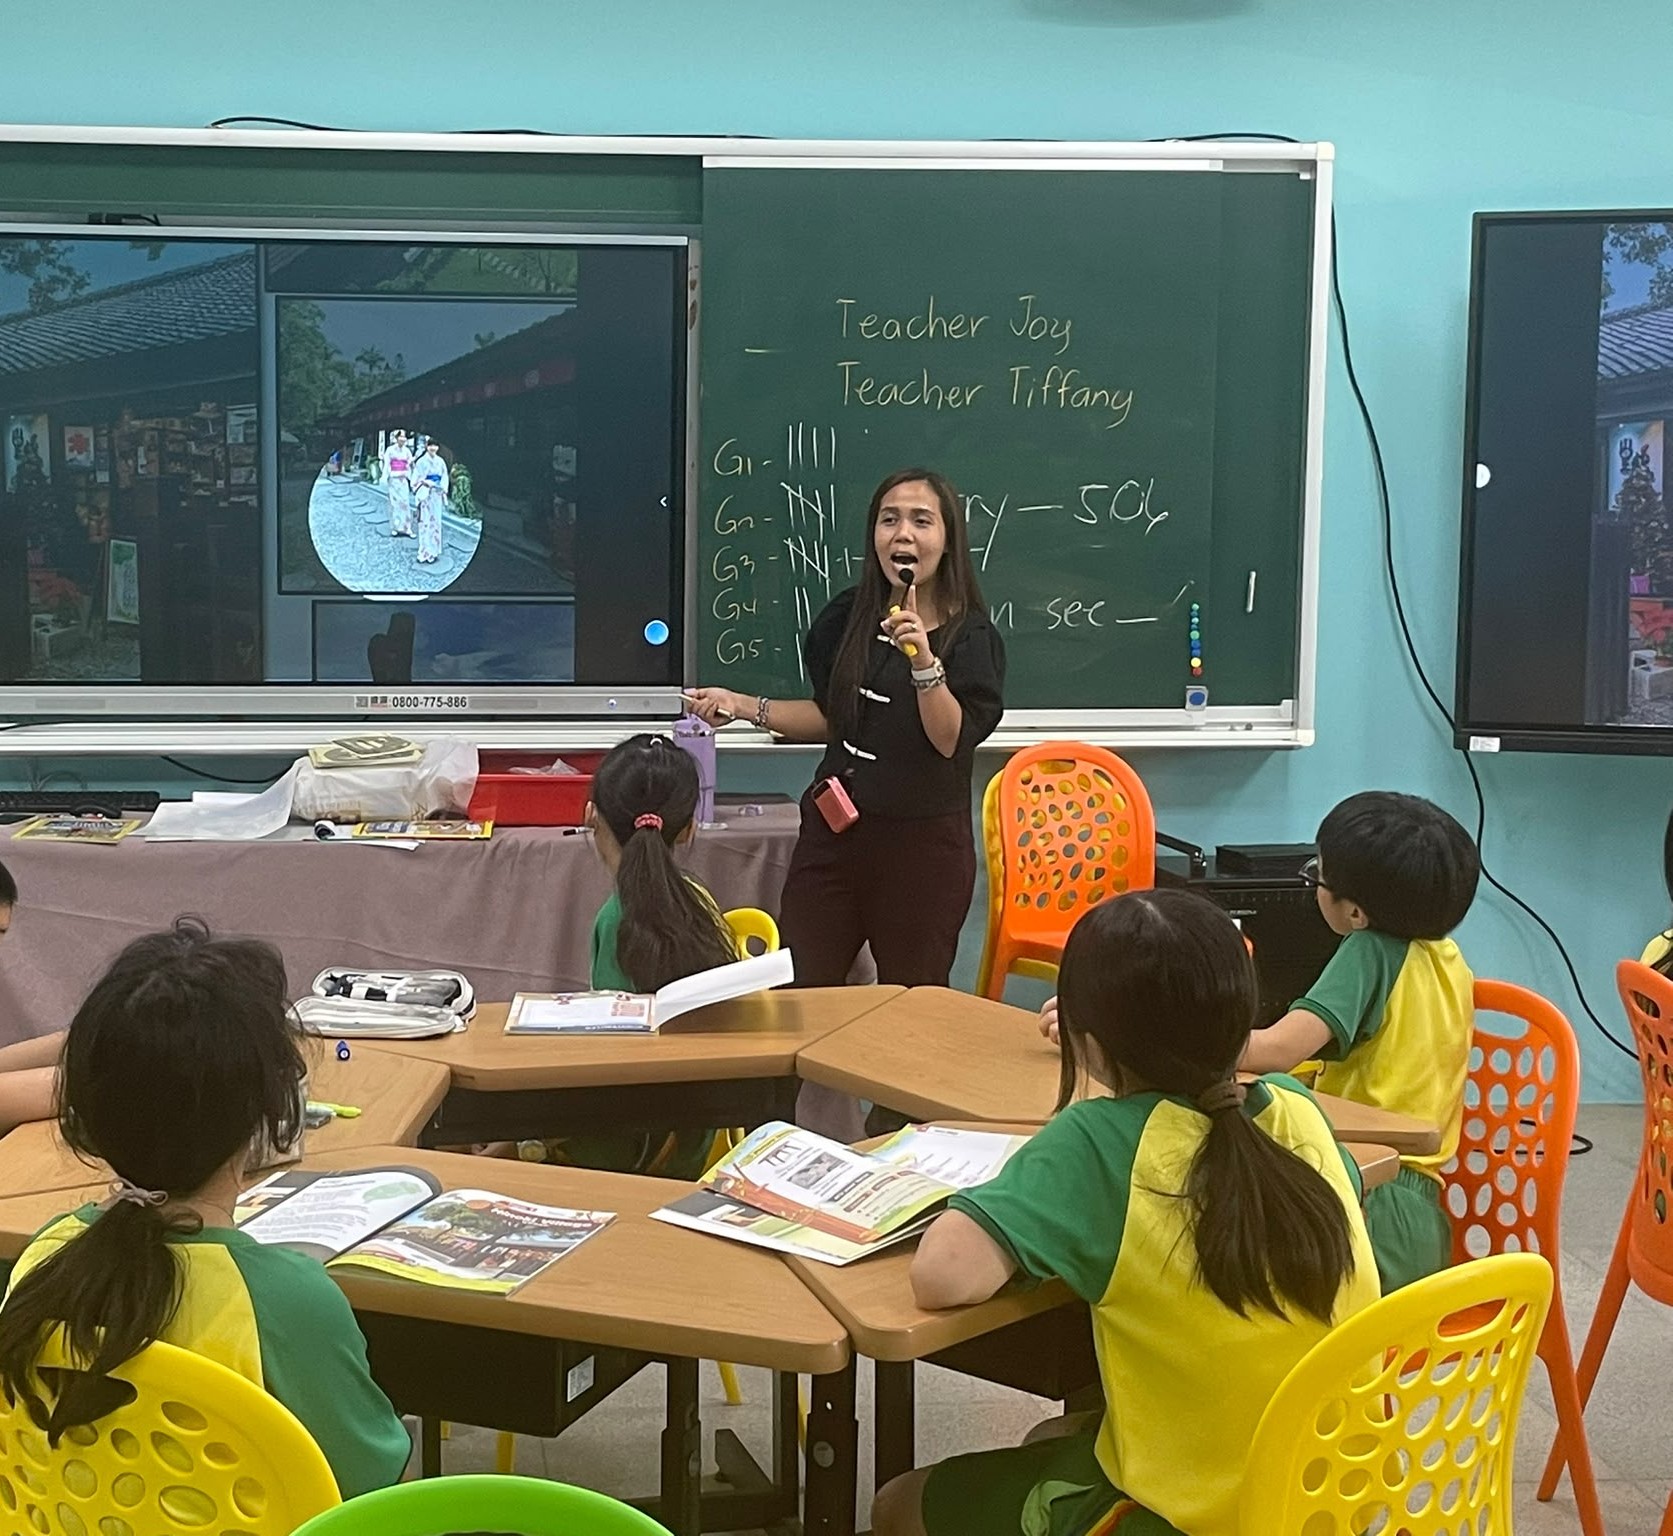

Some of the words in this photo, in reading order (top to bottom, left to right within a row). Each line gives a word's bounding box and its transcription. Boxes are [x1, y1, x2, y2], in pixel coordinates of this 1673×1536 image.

[835, 295, 991, 340] Teacher
[1009, 294, 1072, 356] Joy
[836, 361, 986, 411] Teacher
[1009, 365, 1134, 430] Tiffany
[1046, 597, 1106, 630] see
[392, 696, 468, 708] 0800-775-886
